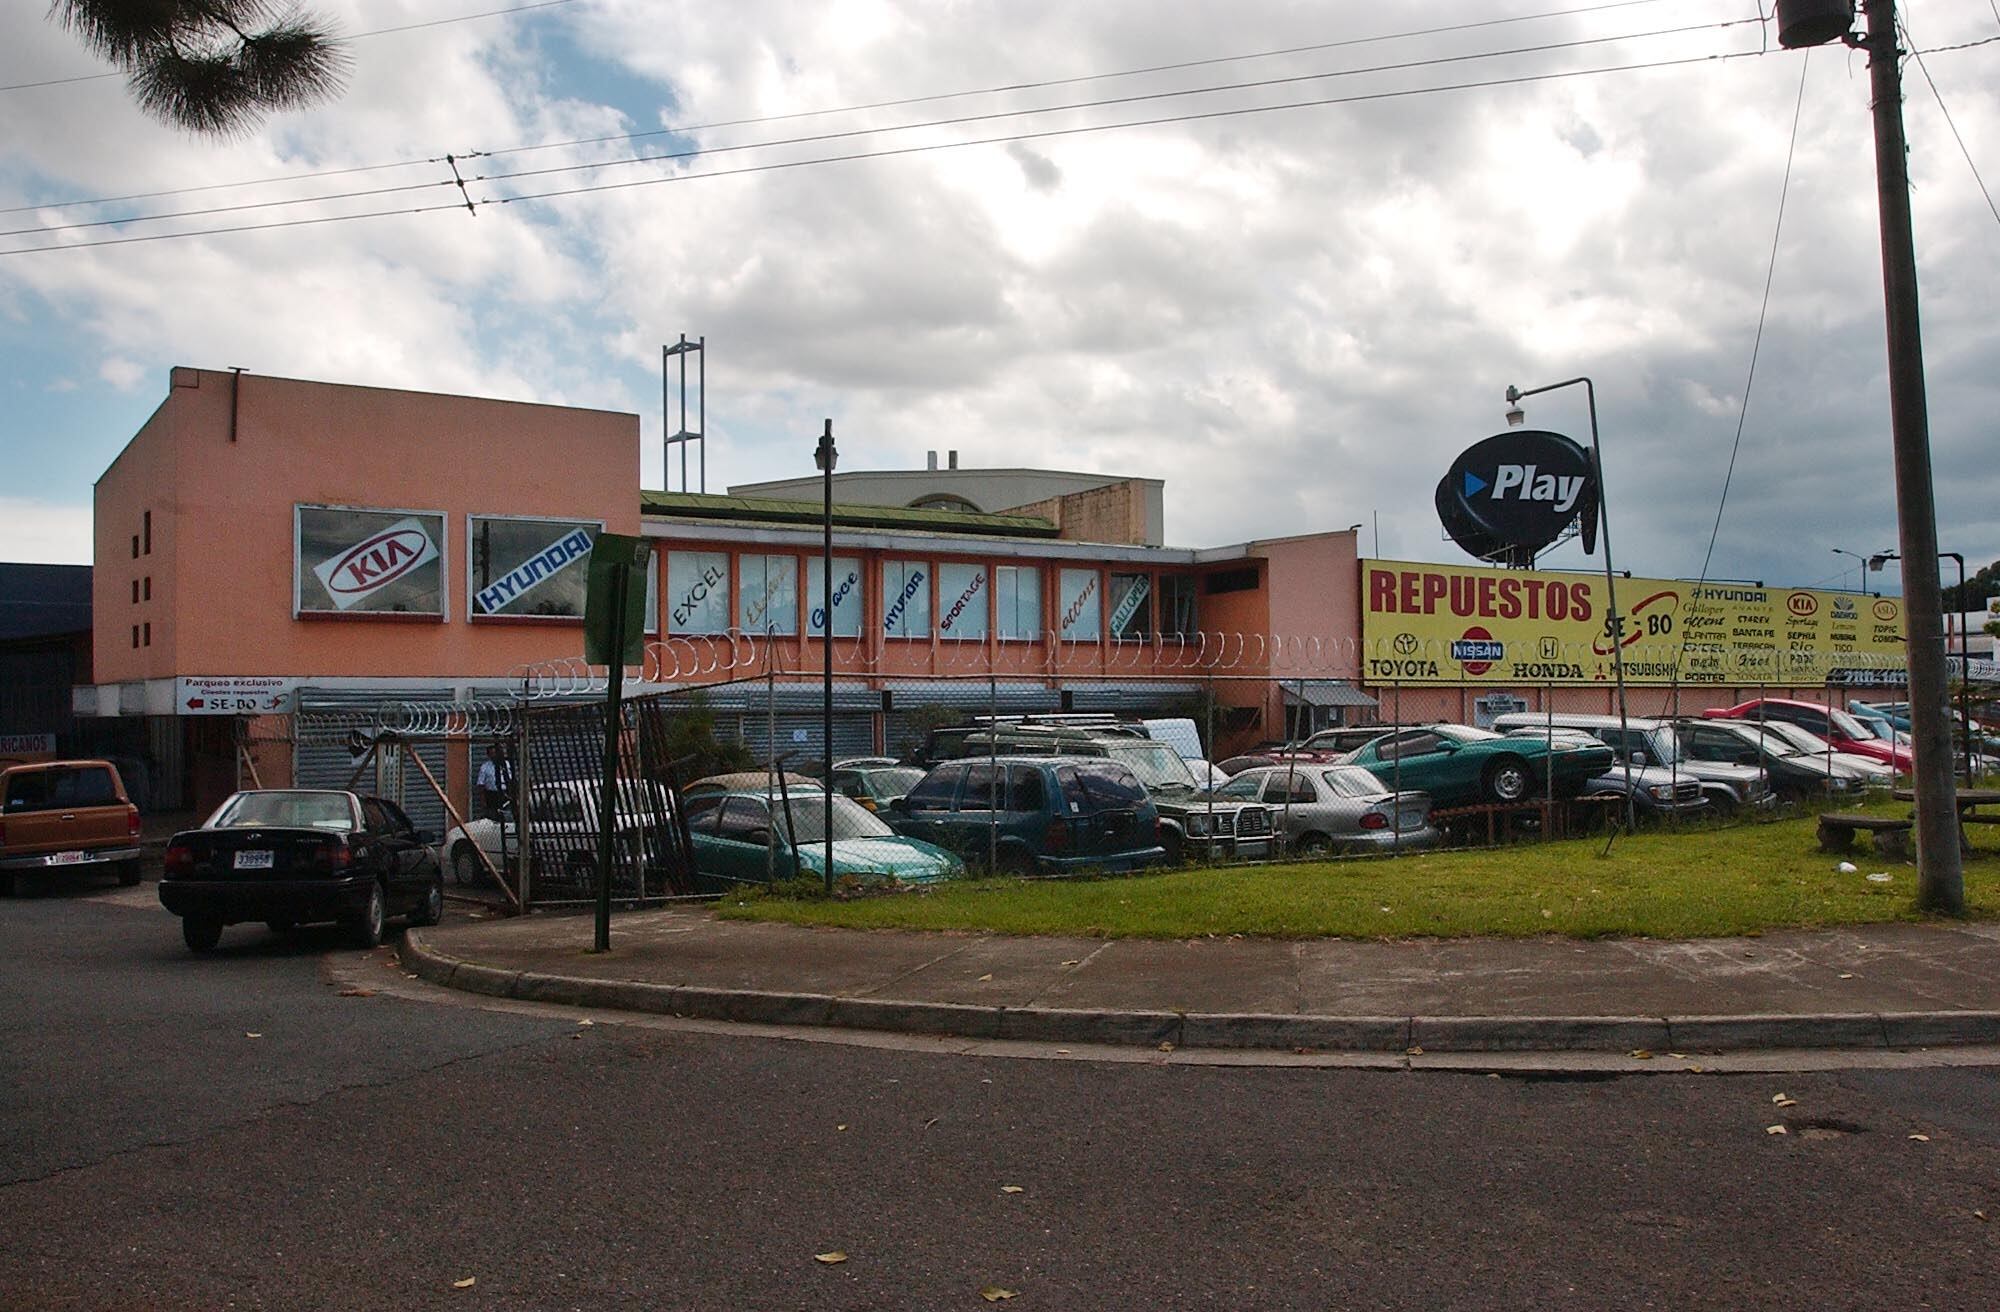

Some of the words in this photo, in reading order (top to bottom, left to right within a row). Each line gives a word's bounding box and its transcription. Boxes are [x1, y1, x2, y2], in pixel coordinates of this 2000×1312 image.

[1491, 464, 1586, 513] Play
[349, 539, 414, 586] KIA
[479, 531, 592, 611] HYUNDAI
[673, 566, 724, 626] EXCEL
[812, 572, 858, 628] Gace
[941, 573, 985, 631] SPORTAGE
[1370, 569, 1592, 622] REPUESTOS
[1704, 589, 1767, 603] HYUNDAI
[1110, 577, 1149, 634] GALLOPER
[1793, 598, 1813, 611] KIA
[1682, 631, 1727, 641] ELANTRA
[1732, 627, 1763, 637] SANTA
[1764, 629, 1775, 638] FE
[1787, 631, 1816, 641] SEPHIA
[1873, 624, 1898, 634] TOPIC
[1453, 642, 1502, 659] NISSAN
[1834, 643, 1853, 653] TICO
[1370, 659, 1439, 677] TOYOTA
[1512, 663, 1584, 678] HONDA
[1609, 662, 1678, 678] MTSUBISHI
[185, 678, 231, 688] Parqueo
[233, 679, 283, 687] exclusivo
[210, 698, 257, 710] SE-BO
